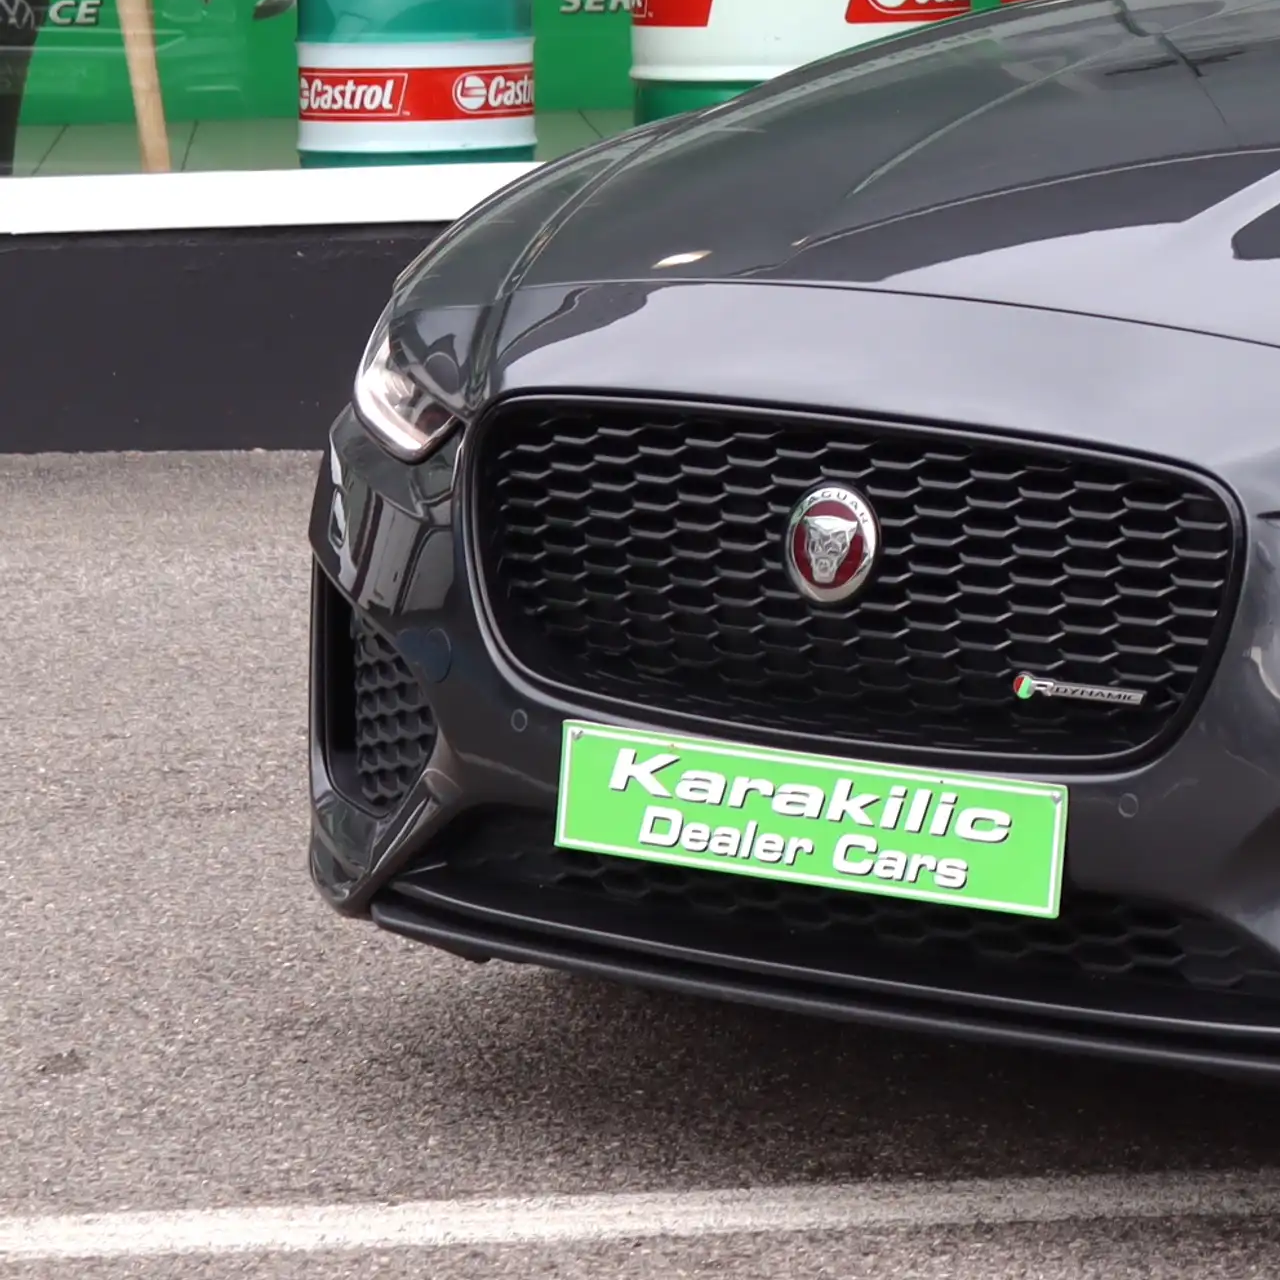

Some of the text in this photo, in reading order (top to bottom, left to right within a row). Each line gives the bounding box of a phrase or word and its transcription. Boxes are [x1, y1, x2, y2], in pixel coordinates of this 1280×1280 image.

[310, 77, 395, 111] Castrol
[796, 490, 870, 525] JAGUAR
[1054, 686, 1140, 703] DYNAMIC
[609, 748, 1013, 845] Karakilic
[638, 810, 969, 891] Dealer Cars
